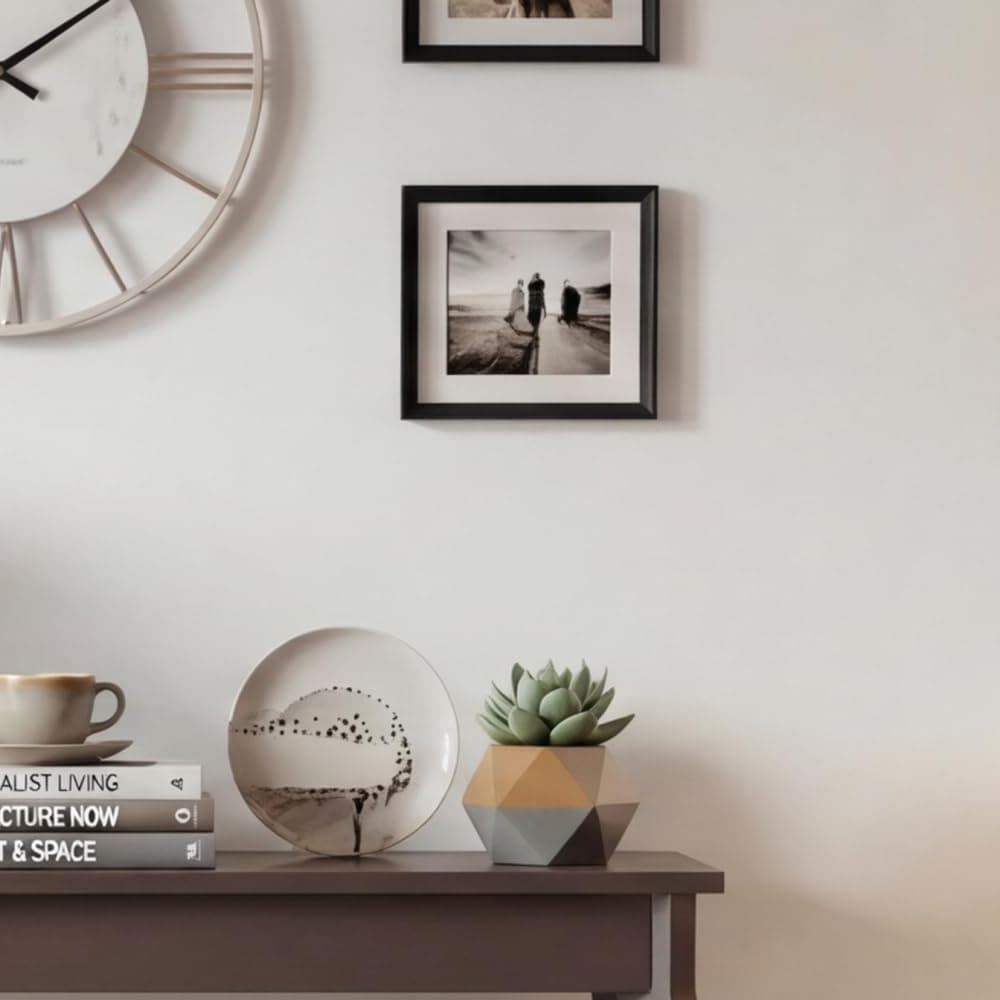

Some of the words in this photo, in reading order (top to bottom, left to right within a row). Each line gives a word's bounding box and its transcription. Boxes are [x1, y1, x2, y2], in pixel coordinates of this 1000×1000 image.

[57, 773, 119, 792] LIVING
[70, 805, 120, 828] NOW
[12, 840, 27, 863] &
[31, 840, 97, 863] SPACE
